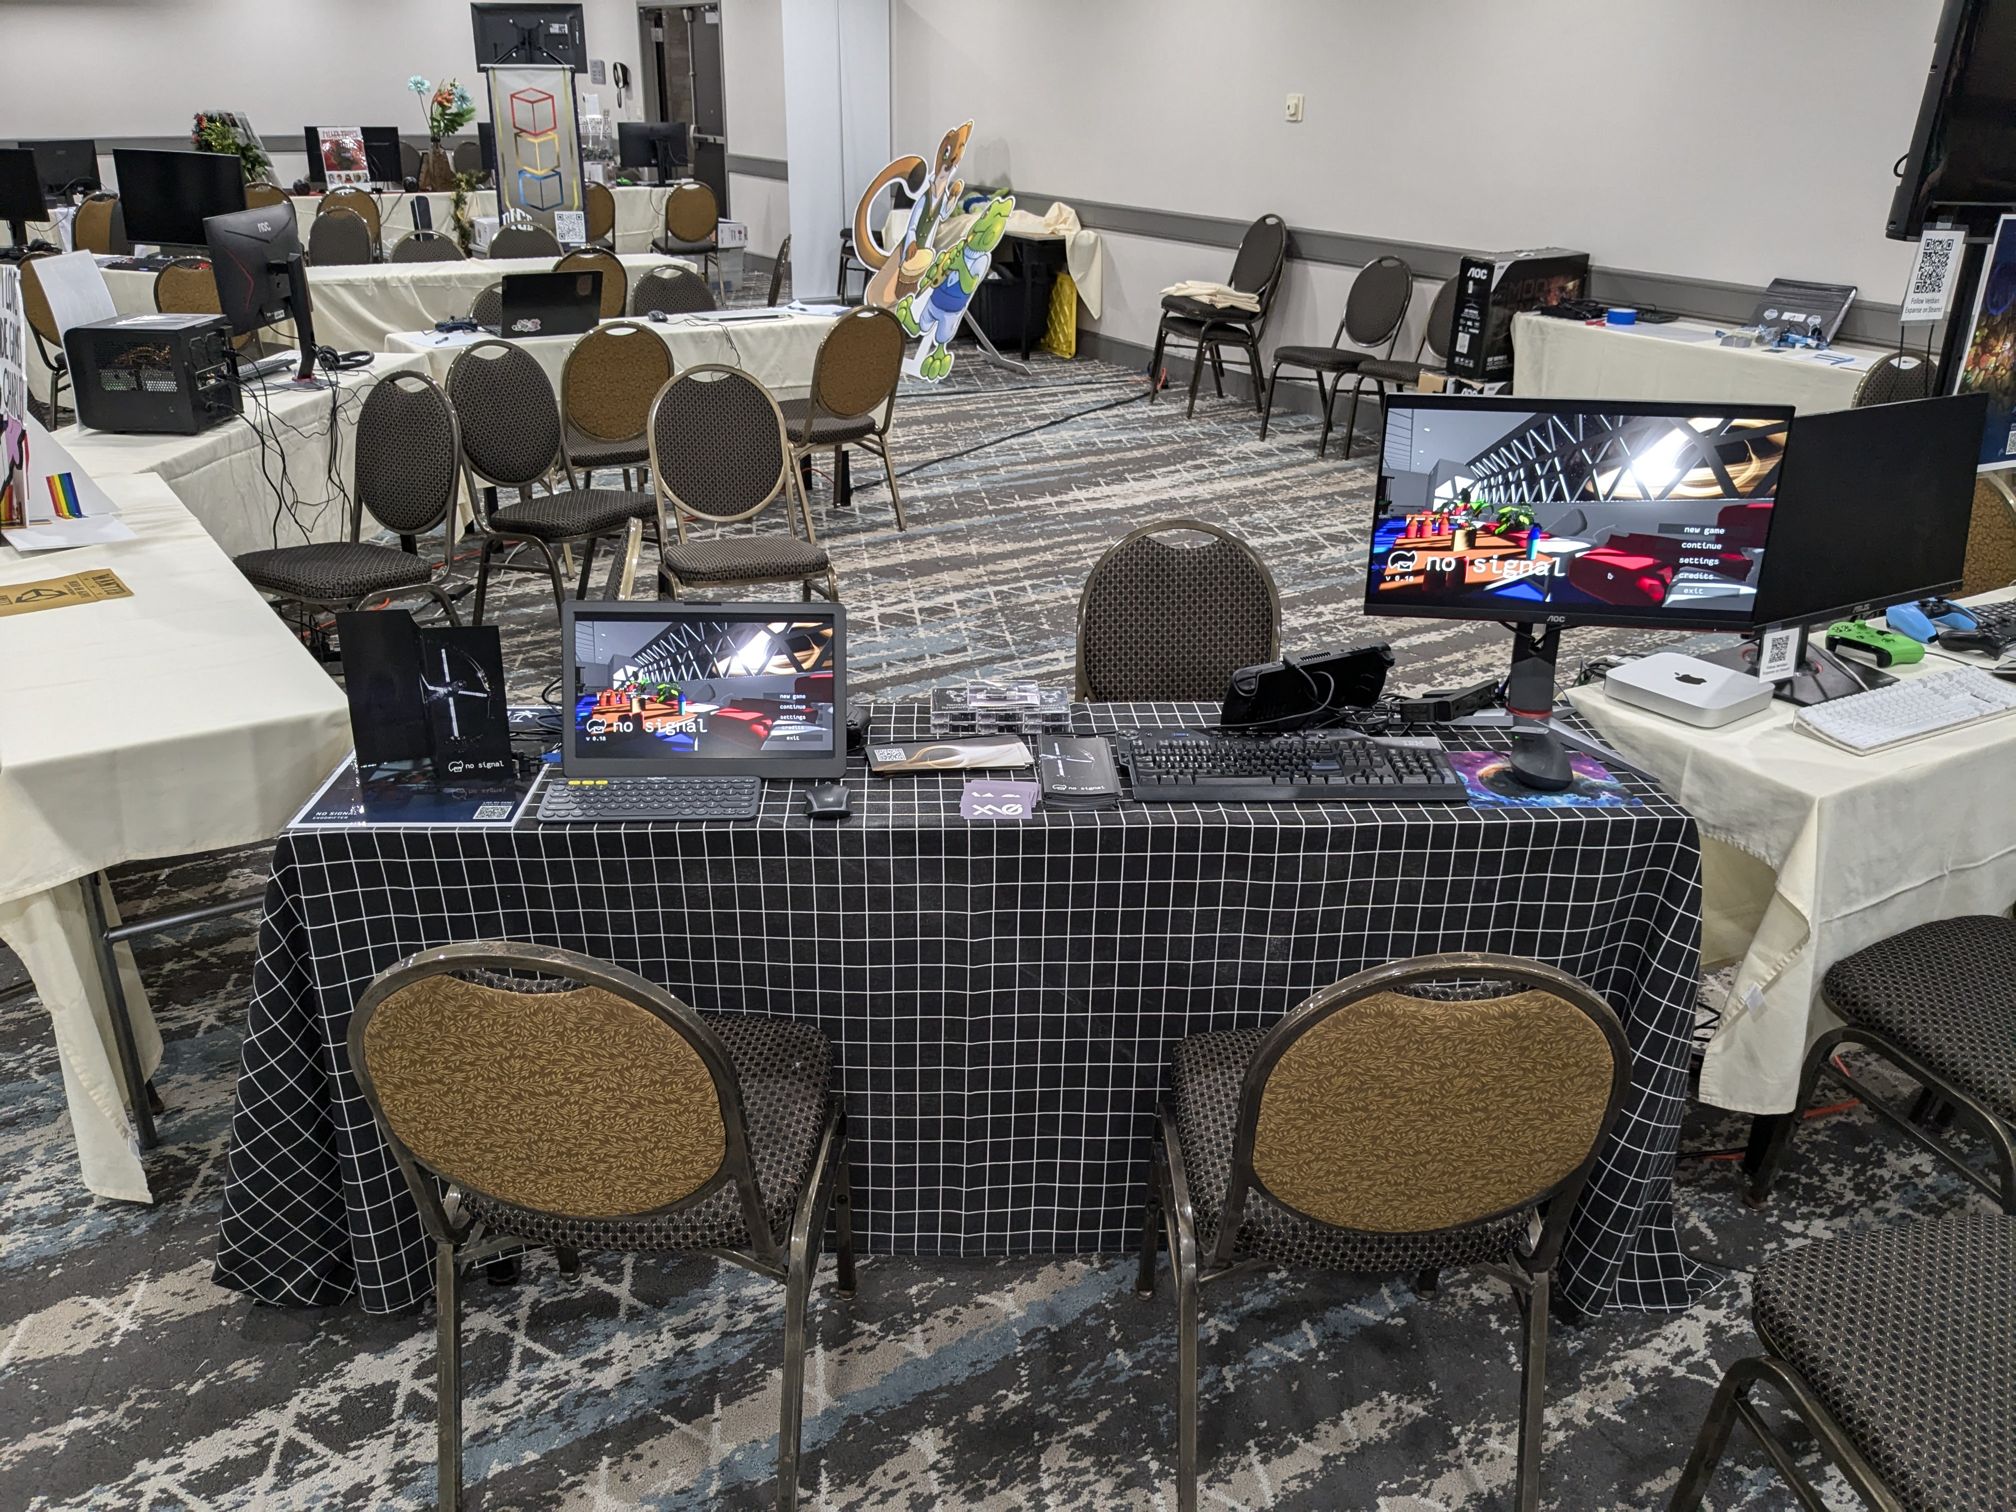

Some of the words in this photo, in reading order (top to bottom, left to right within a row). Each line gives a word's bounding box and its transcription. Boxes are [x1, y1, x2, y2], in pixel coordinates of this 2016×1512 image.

[1467, 267, 1488, 279] AOC
[1683, 526, 1701, 534] new
[1703, 527, 1725, 536] game
[1681, 541, 1722, 550] continue
[1678, 556, 1720, 566] settings
[1426, 556, 1456, 572] no
[1472, 555, 1566, 579] signal
[1678, 571, 1714, 580] credits
[613, 721, 634, 733] no
[645, 718, 708, 736] signal
[478, 760, 505, 769] signal
